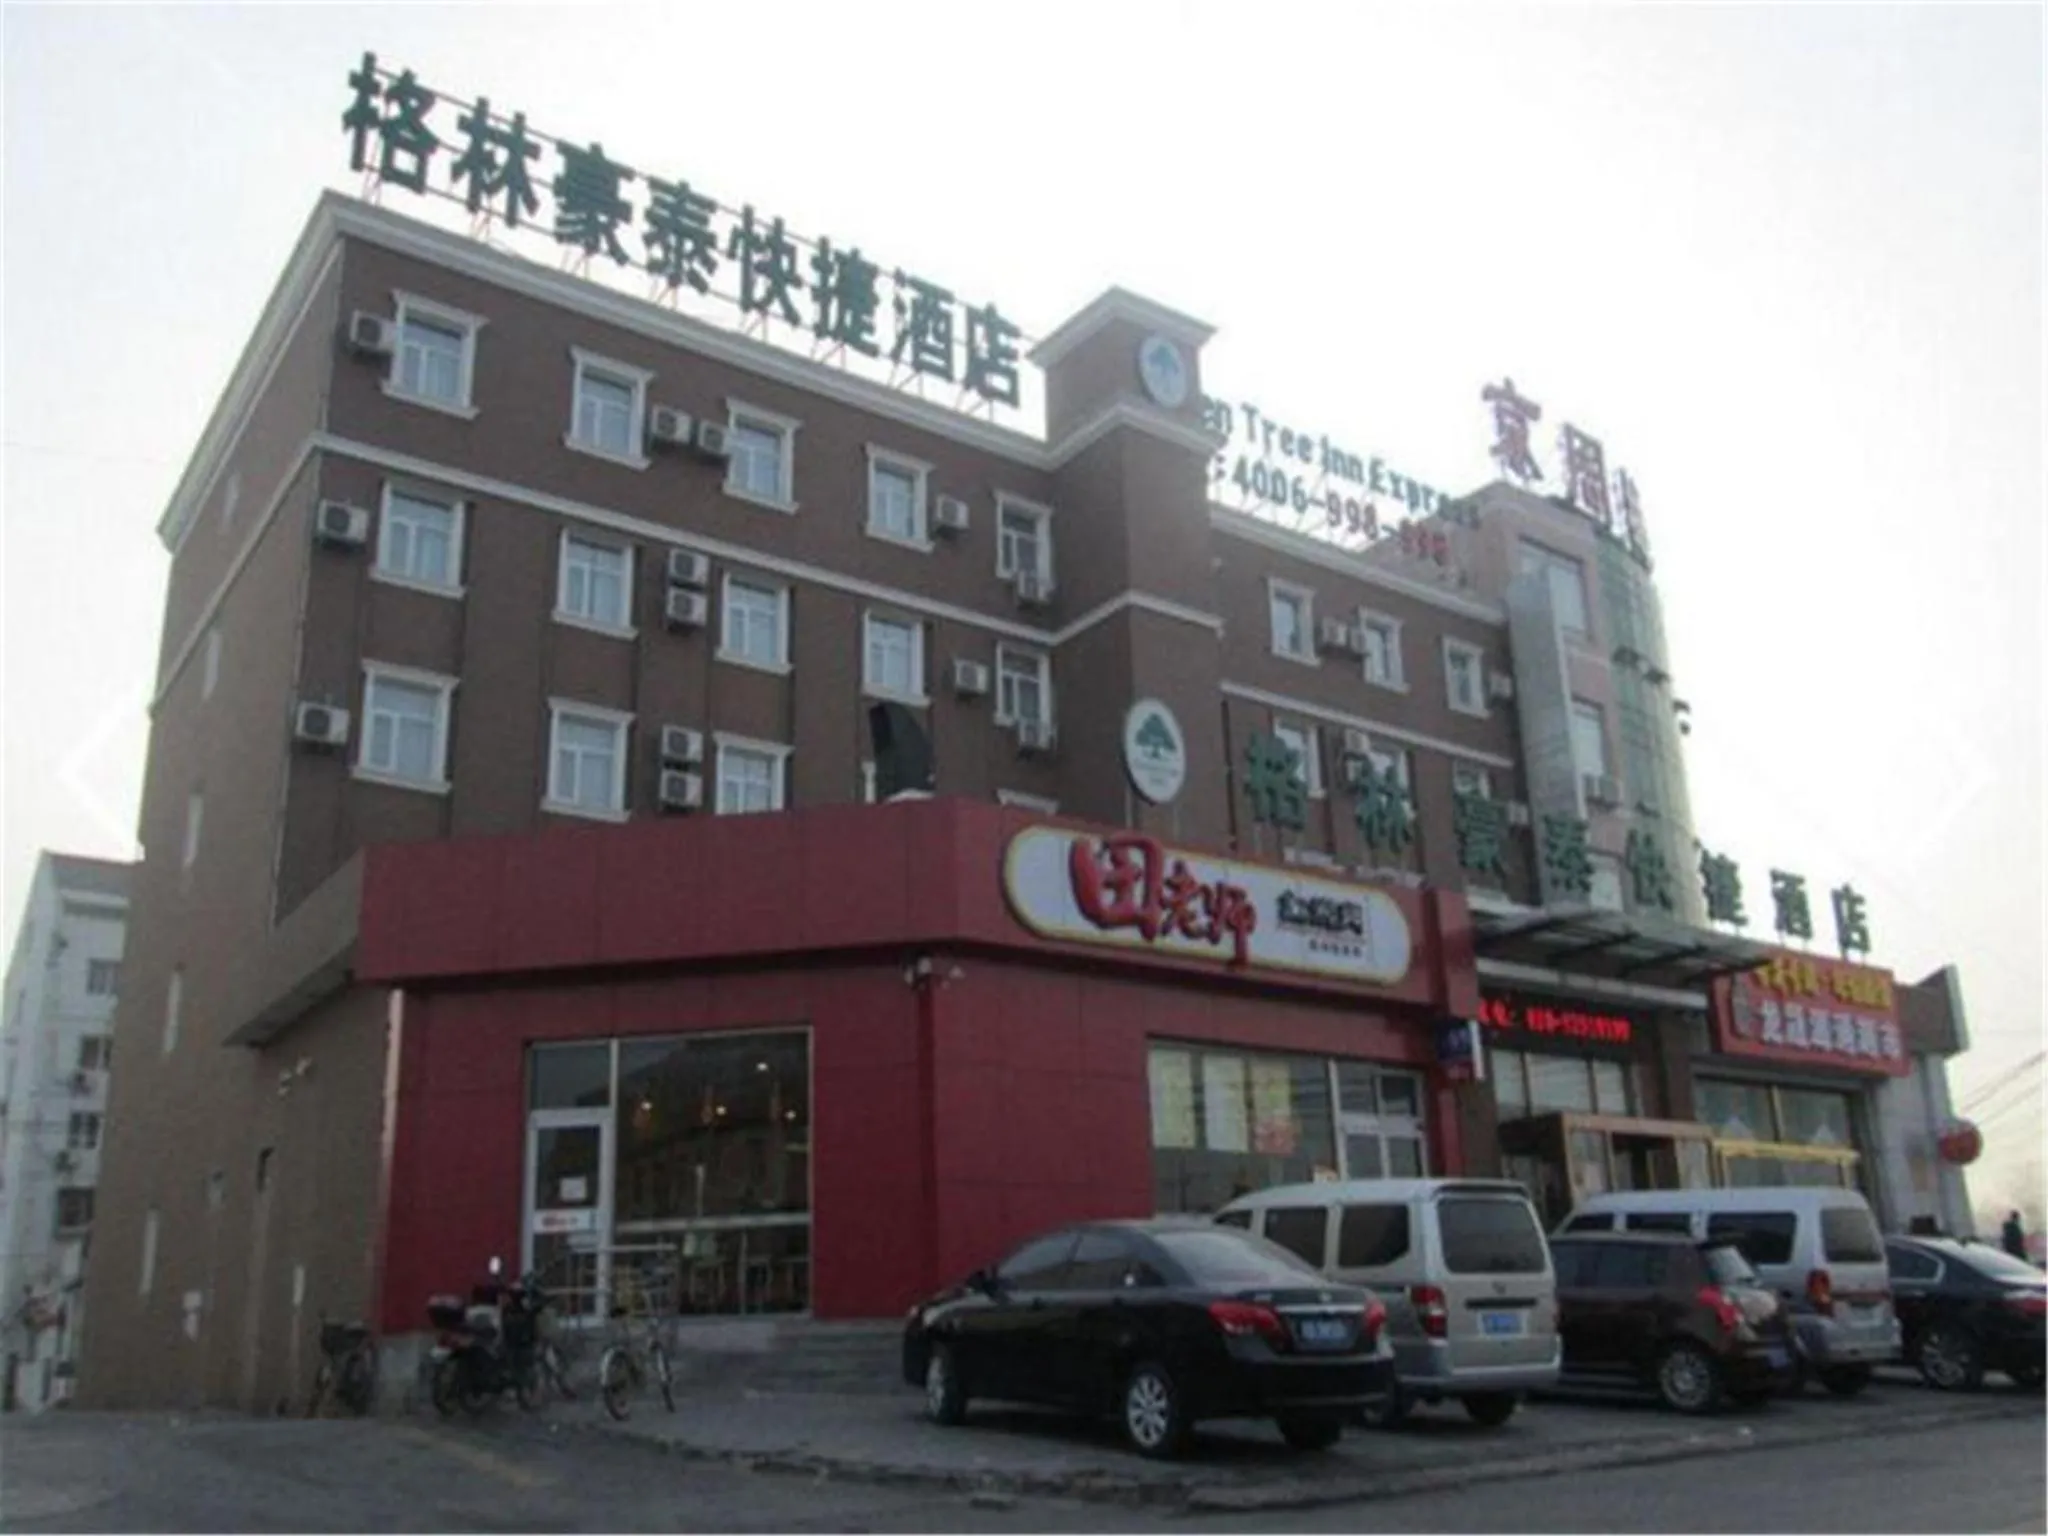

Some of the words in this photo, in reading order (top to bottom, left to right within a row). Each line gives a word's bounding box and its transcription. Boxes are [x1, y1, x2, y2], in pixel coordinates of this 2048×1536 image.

[342, 51, 1022, 408] 格林豪泰快捷酒店
[1202, 394, 1233, 437] en
[1241, 402, 1313, 464] Tree
[1069, 830, 1257, 971] 田老师
[1244, 730, 1872, 957] 格林豪泰快捷酒店
